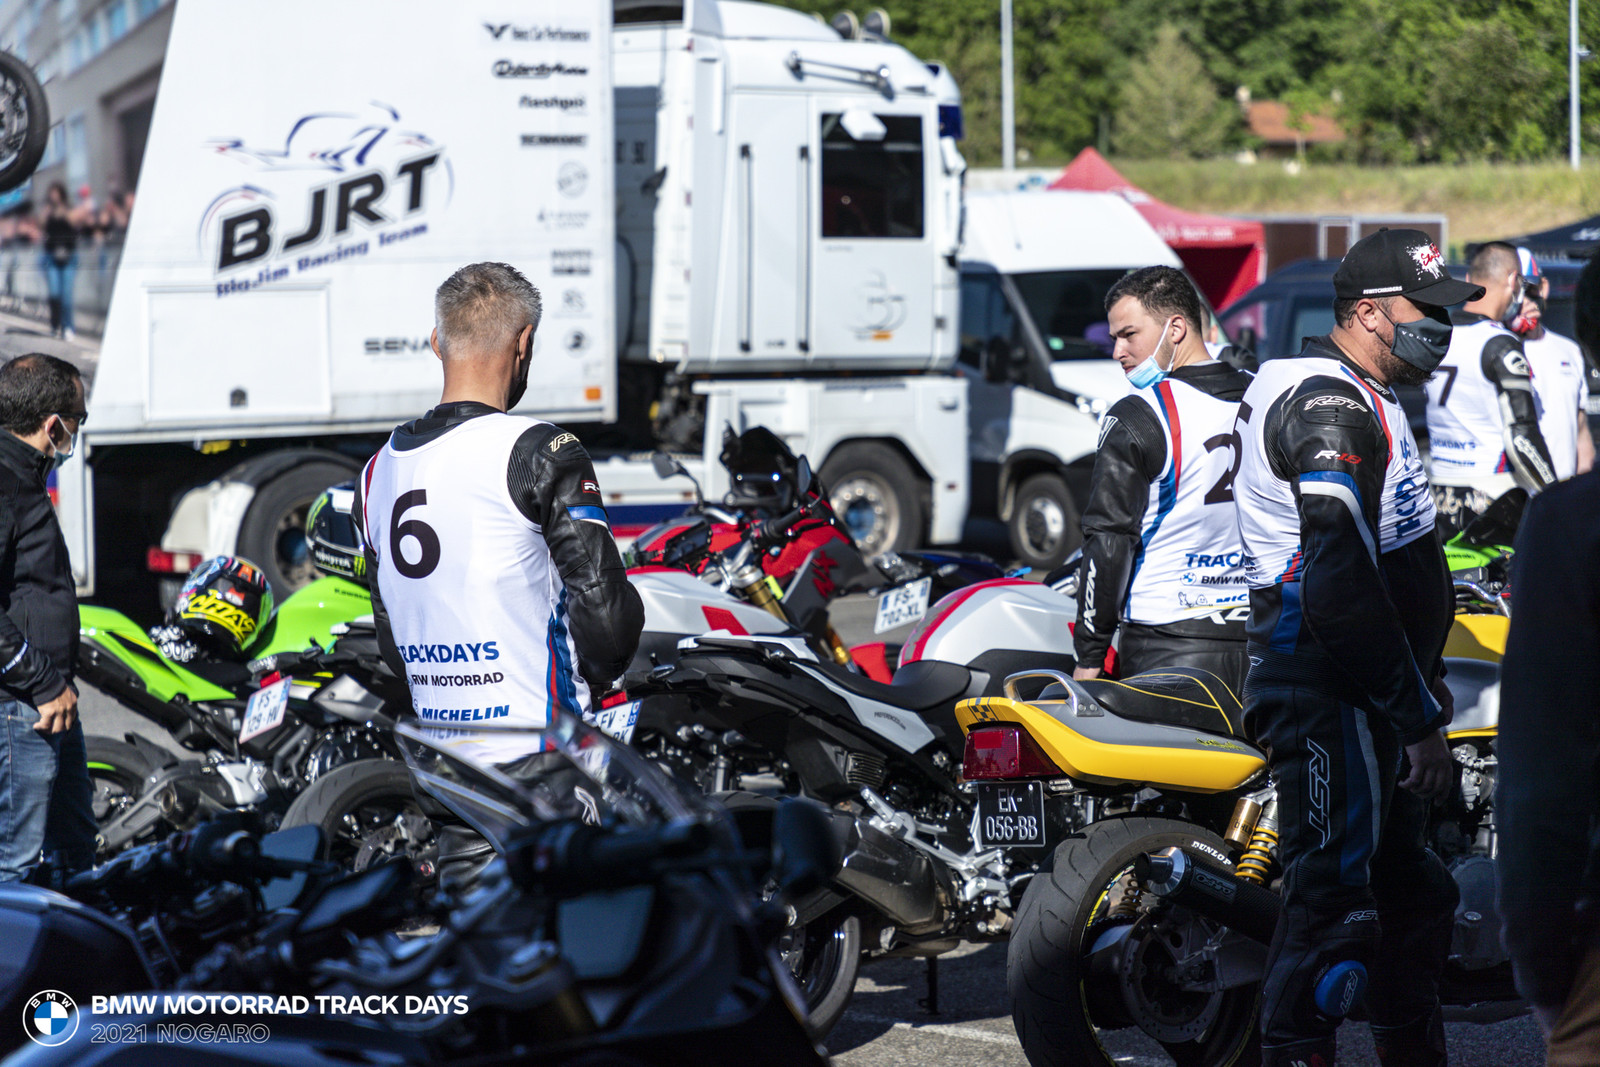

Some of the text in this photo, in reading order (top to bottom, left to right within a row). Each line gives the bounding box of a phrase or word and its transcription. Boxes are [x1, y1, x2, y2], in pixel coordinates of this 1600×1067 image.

[216, 152, 440, 271] BJRT
[297, 240, 369, 273] Racing
[379, 223, 428, 247] Team
[1436, 365, 1458, 407] 7
[1303, 395, 1368, 412] RST
[548, 432, 580, 452] RS
[390, 489, 441, 579] 6
[1185, 553, 1244, 568] TRAC
[1201, 575, 1231, 585] BMW
[396, 641, 500, 663] RACKDAYS
[431, 671, 504, 687] MOTORRAD
[422, 704, 510, 721] MICHELIN
[998, 788, 1023, 812] EK-
[1306, 737, 1331, 850] RST
[986, 815, 1038, 841] 056-BB
[1191, 840, 1232, 866] DUNLOP
